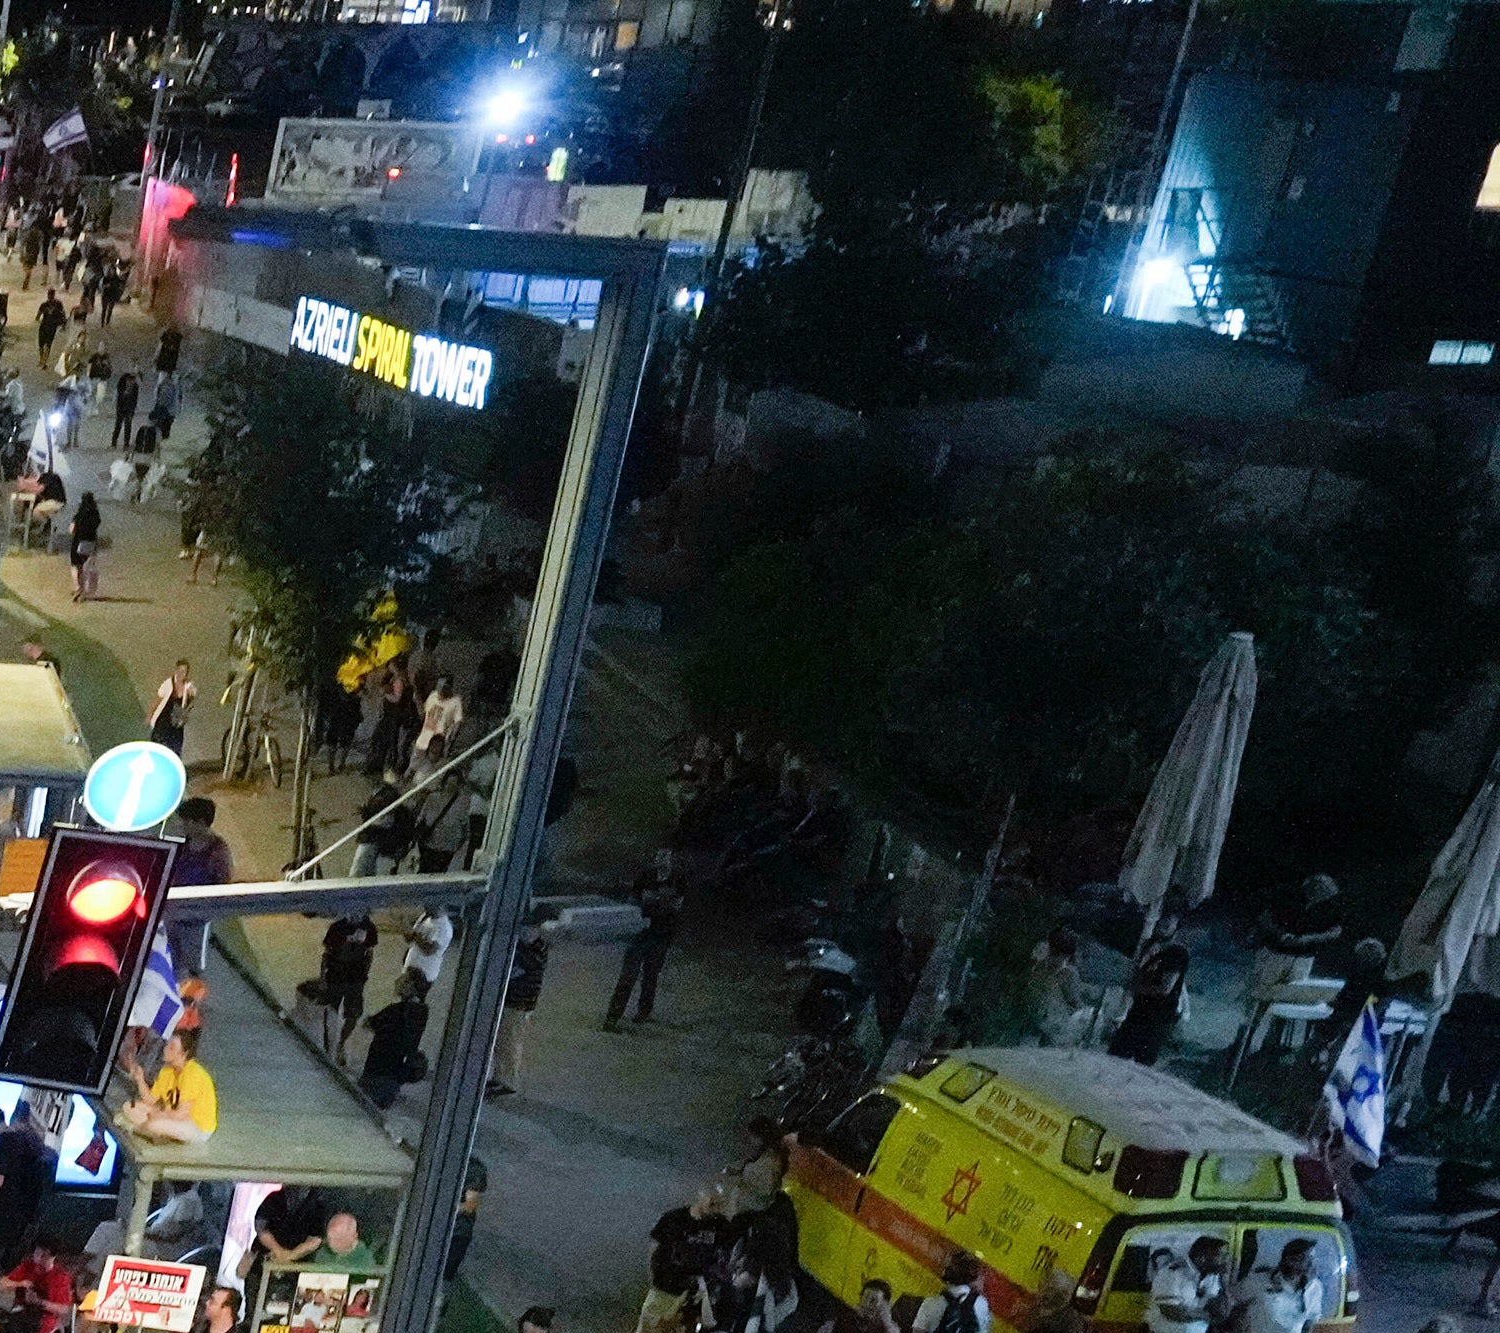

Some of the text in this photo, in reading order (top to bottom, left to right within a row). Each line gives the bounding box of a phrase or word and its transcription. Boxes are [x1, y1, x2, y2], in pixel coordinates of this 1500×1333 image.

[290, 295, 493, 410] AZRIELI SPIRAL TOWER
[149, 1272, 185, 1290] אנחנו
